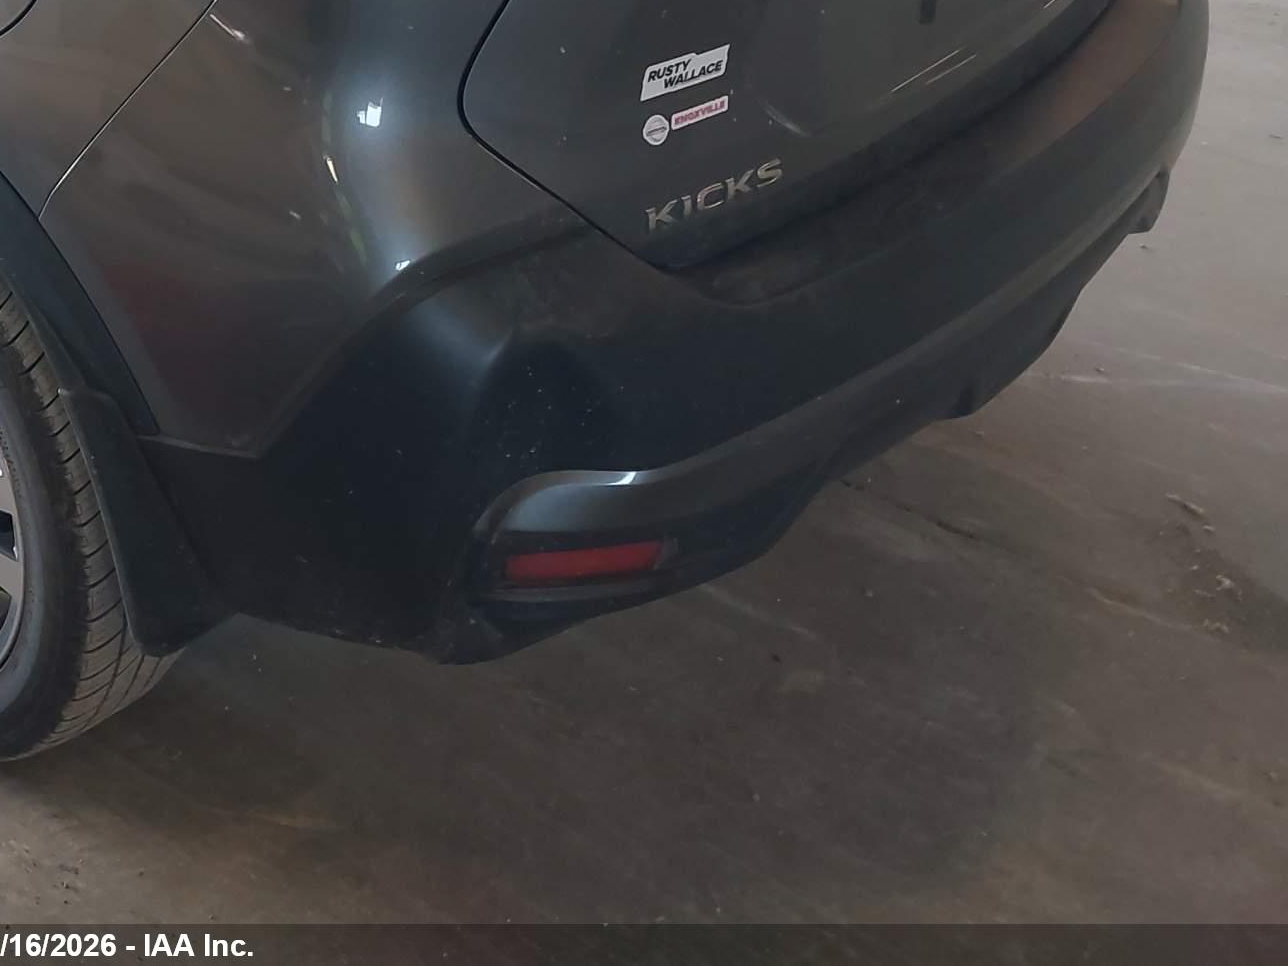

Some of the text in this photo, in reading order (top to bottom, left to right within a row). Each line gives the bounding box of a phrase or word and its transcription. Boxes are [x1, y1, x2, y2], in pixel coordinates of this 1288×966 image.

[648, 58, 692, 83] RUSTY
[663, 60, 724, 89] WALLACE
[674, 100, 726, 126] KNOXVILLE
[645, 158, 783, 232] KICKS
